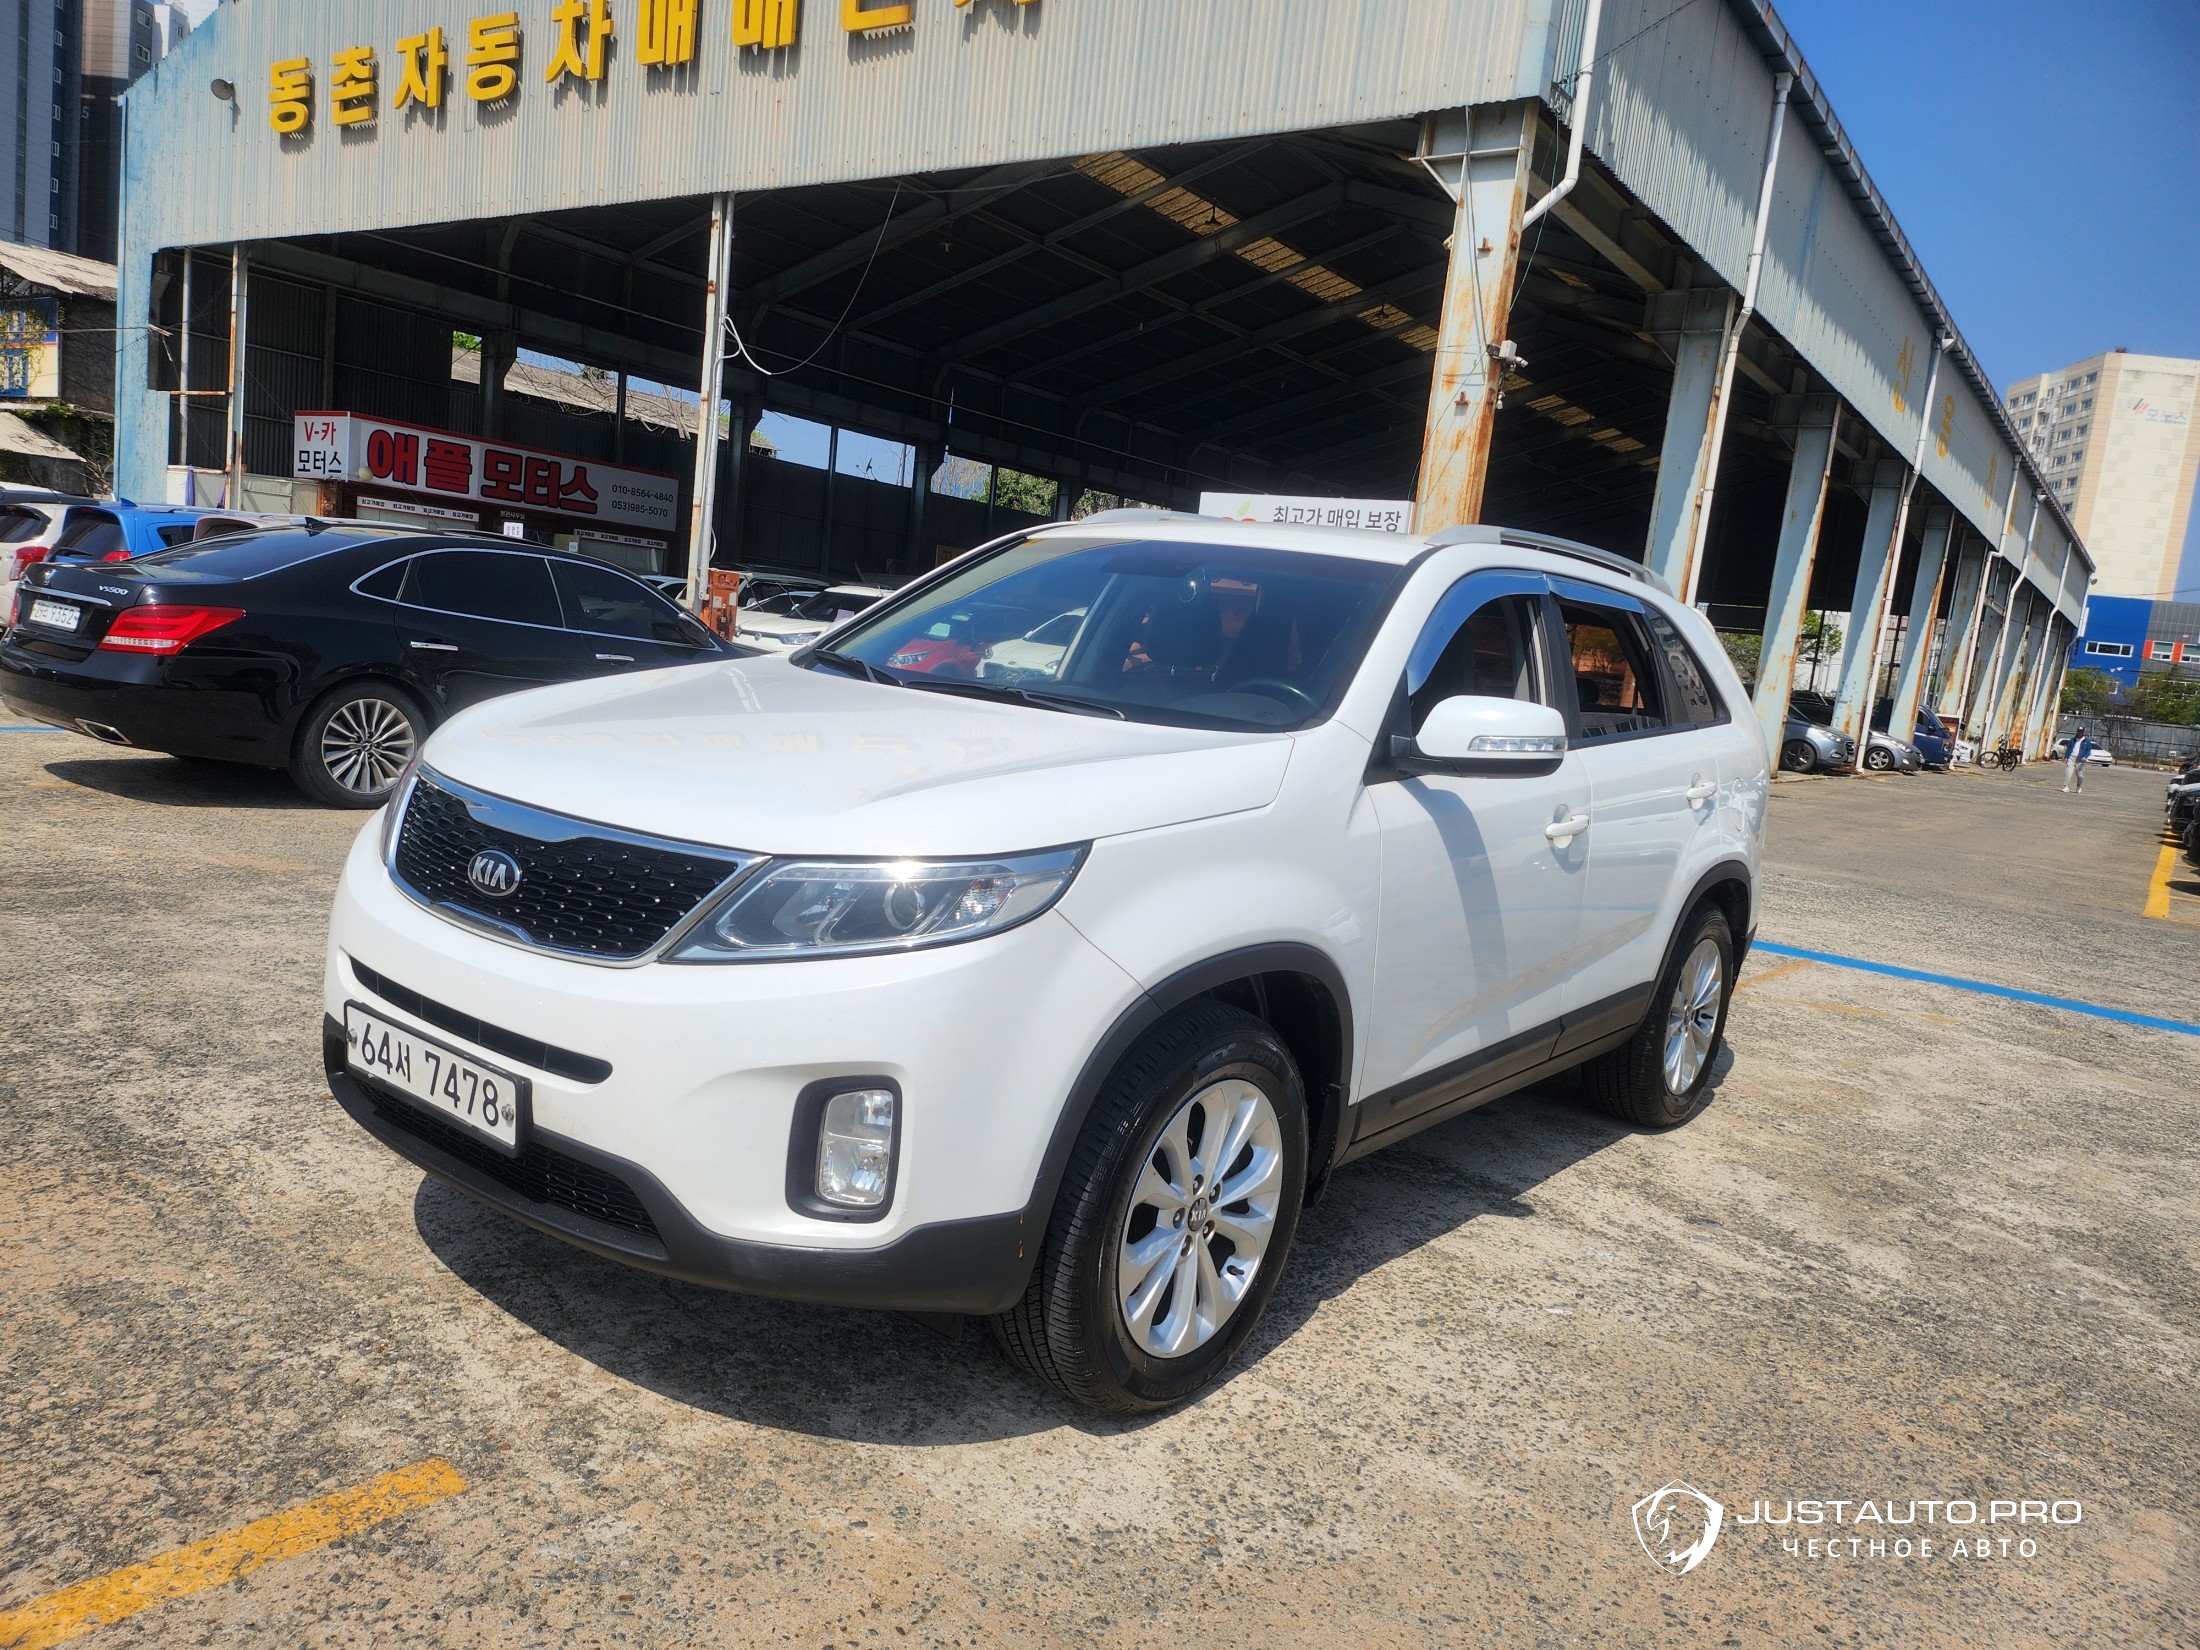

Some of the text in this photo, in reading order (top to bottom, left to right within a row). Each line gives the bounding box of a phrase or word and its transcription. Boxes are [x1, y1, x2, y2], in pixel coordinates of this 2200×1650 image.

[304, 421, 337, 446] V-카
[298, 449, 342, 473] 모터스
[366, 429, 599, 515] 애플 모터스
[611, 483, 674, 503] 010-8564-4840
[611, 500, 669, 518] 053)985-5070
[1272, 506, 1402, 533] 최고가 매입 보장
[472, 856, 507, 890] KIA
[361, 1022, 499, 1127] 64서 7478
[1191, 1209, 1206, 1222] KIA
